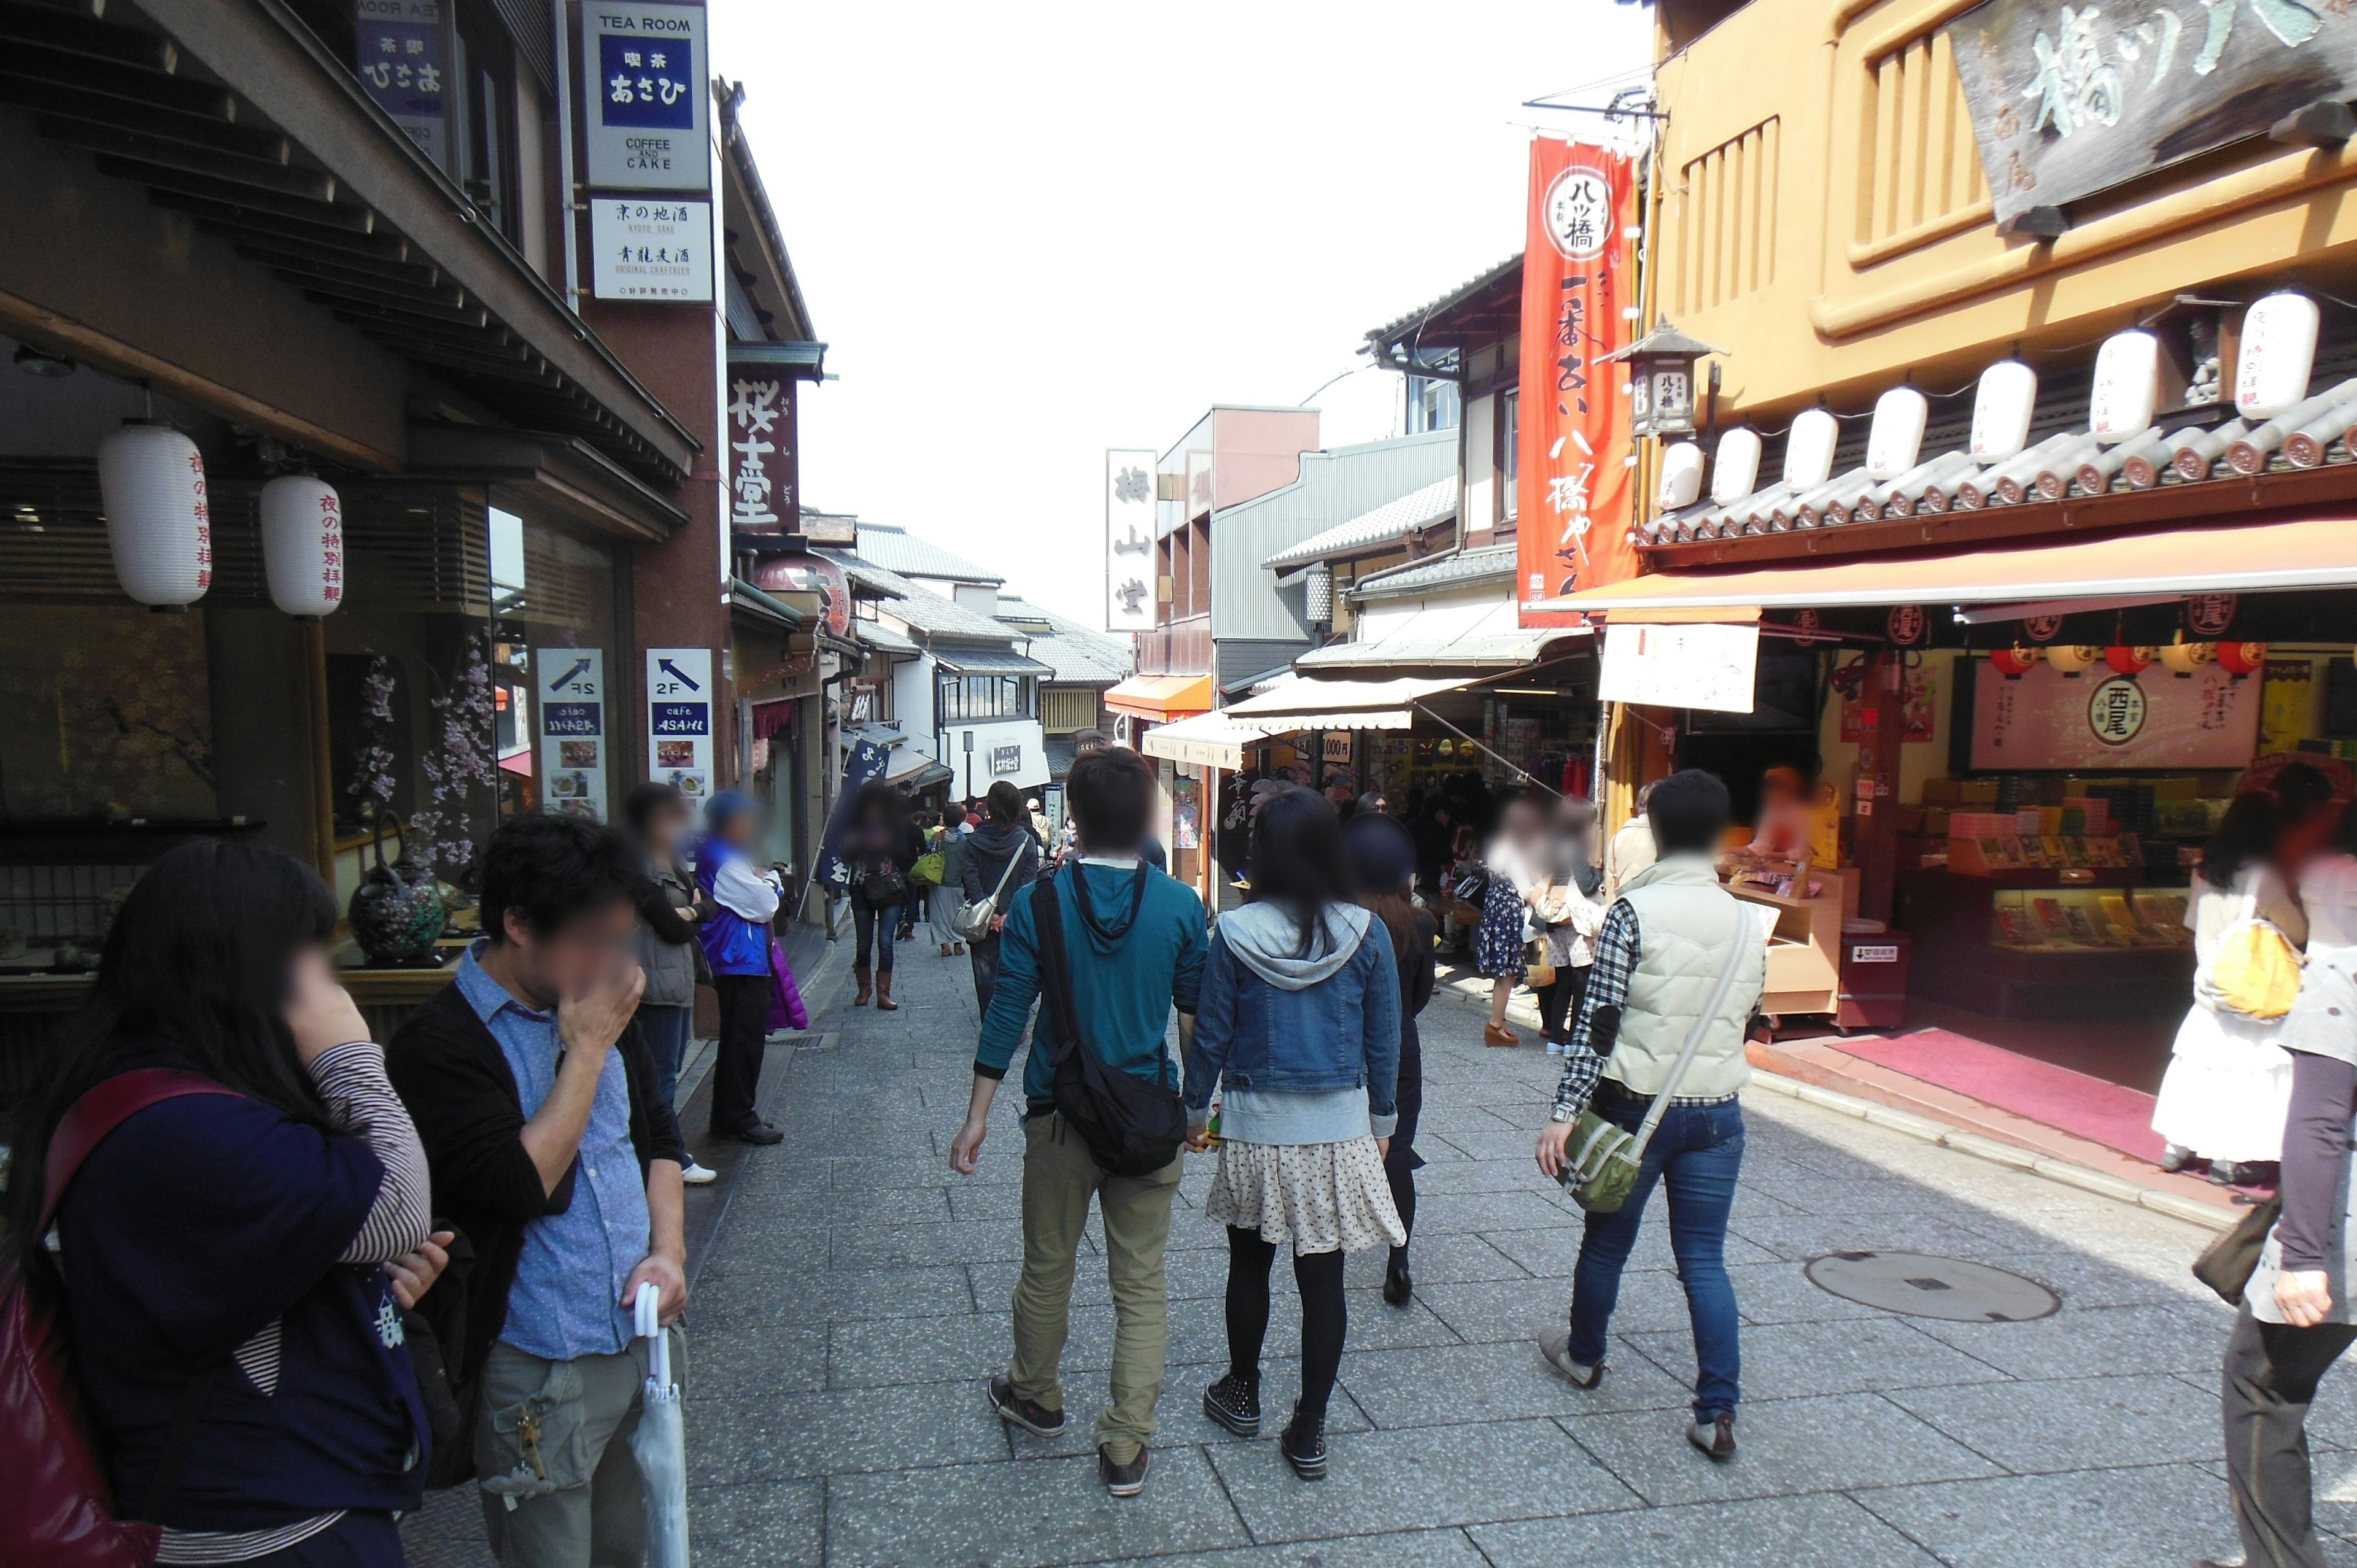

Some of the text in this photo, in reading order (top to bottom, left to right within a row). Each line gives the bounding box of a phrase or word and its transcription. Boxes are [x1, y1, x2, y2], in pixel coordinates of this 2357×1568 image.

[599, 16, 691, 31] TEA ROOM
[624, 52, 667, 68] 喫茶
[610, 74, 686, 104] あさひ
[626, 138, 670, 150] COFFEE
[627, 158, 671, 169] CAKE
[616, 204, 687, 222] 京の地酒
[629, 224, 675, 233] KYOTO SAKE
[617, 245, 689, 263] 青龍麦酒
[616, 265, 647, 274] ORIGINAL
[728, 378, 780, 523] 桜士堂
[656, 683, 679, 694] 2F
[2104, 687, 2130, 735] 西尾
[656, 719, 703, 731] ASAHI
